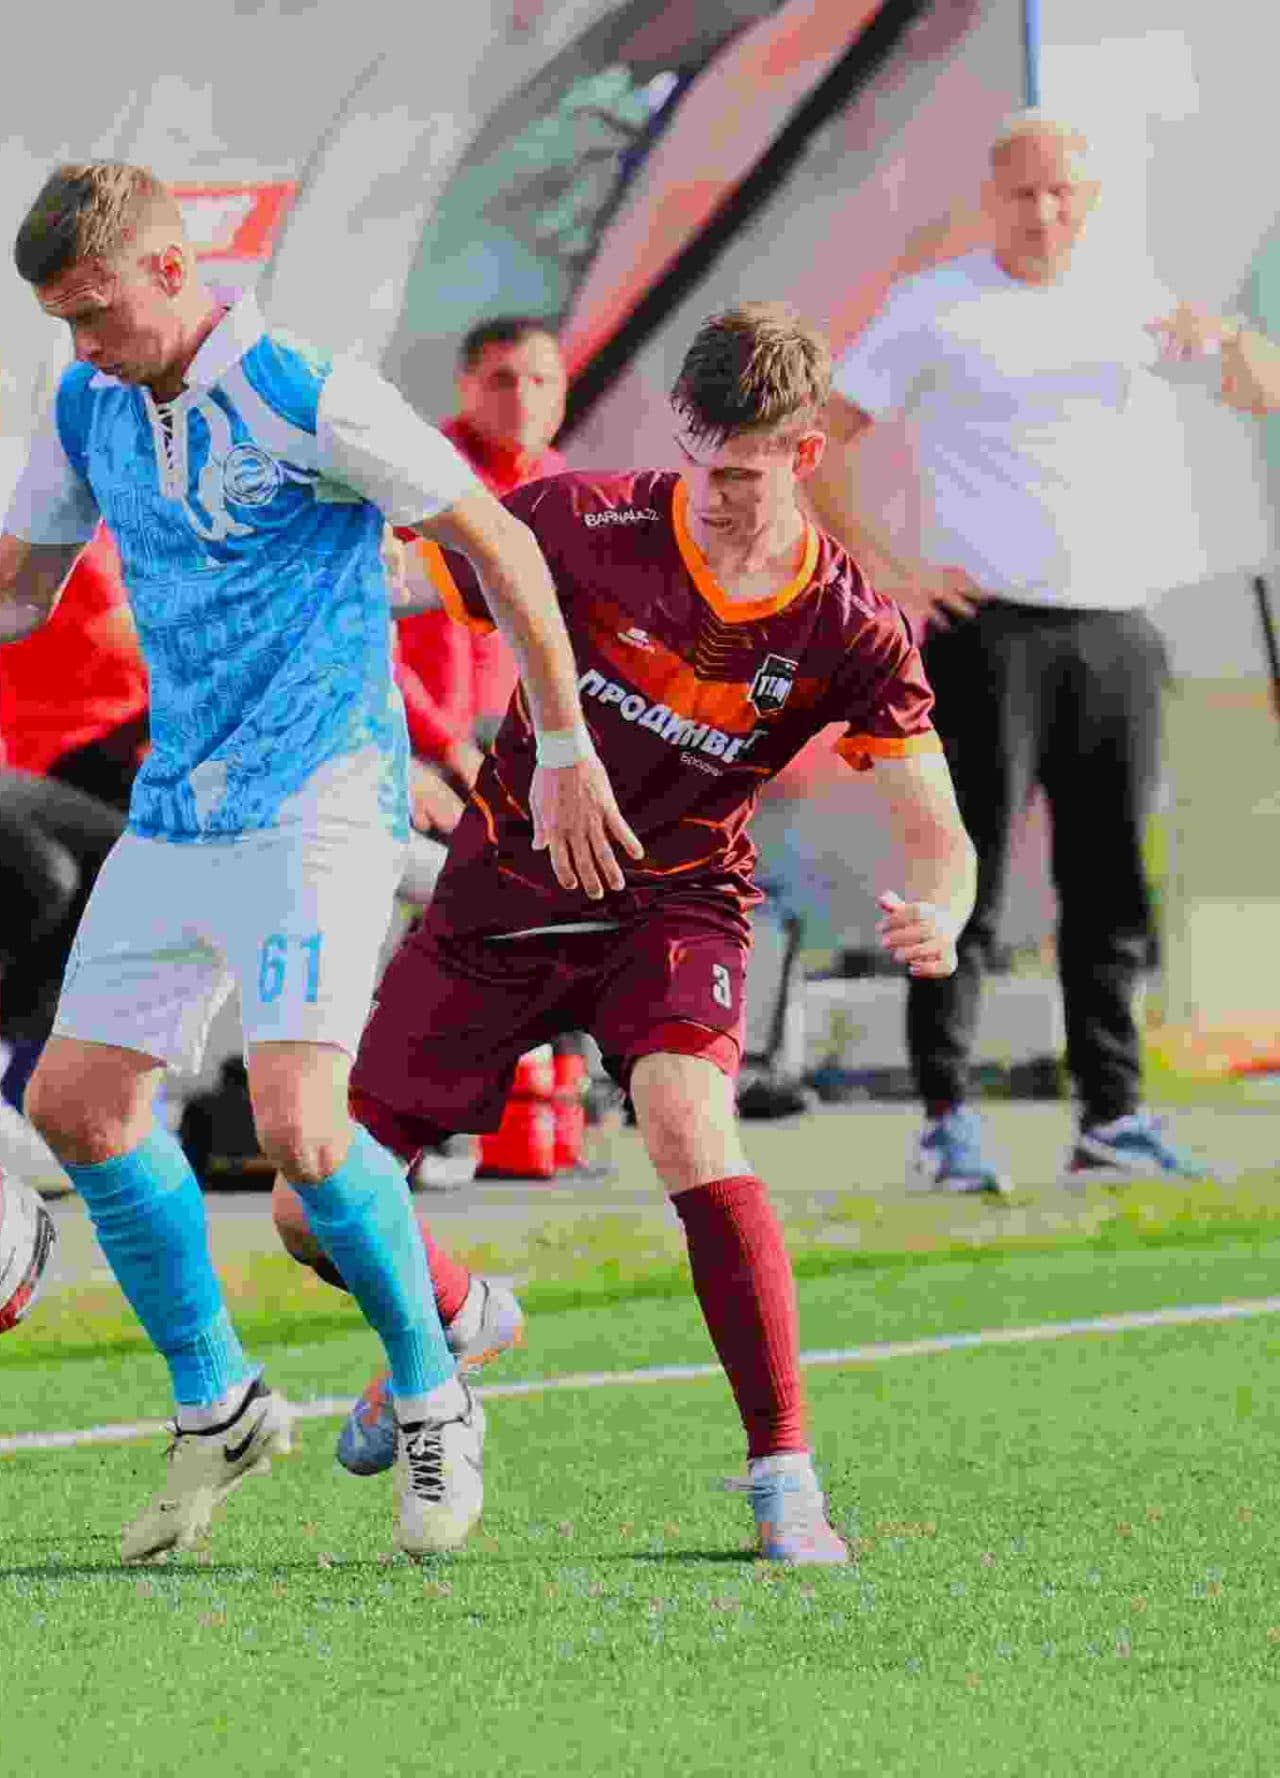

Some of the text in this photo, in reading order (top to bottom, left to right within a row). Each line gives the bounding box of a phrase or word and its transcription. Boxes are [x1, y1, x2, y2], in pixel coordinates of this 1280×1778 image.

[577, 668, 768, 764] ПРОДИНВЕТ
[258, 932, 320, 1003] 61
[712, 963, 732, 1009] 3
